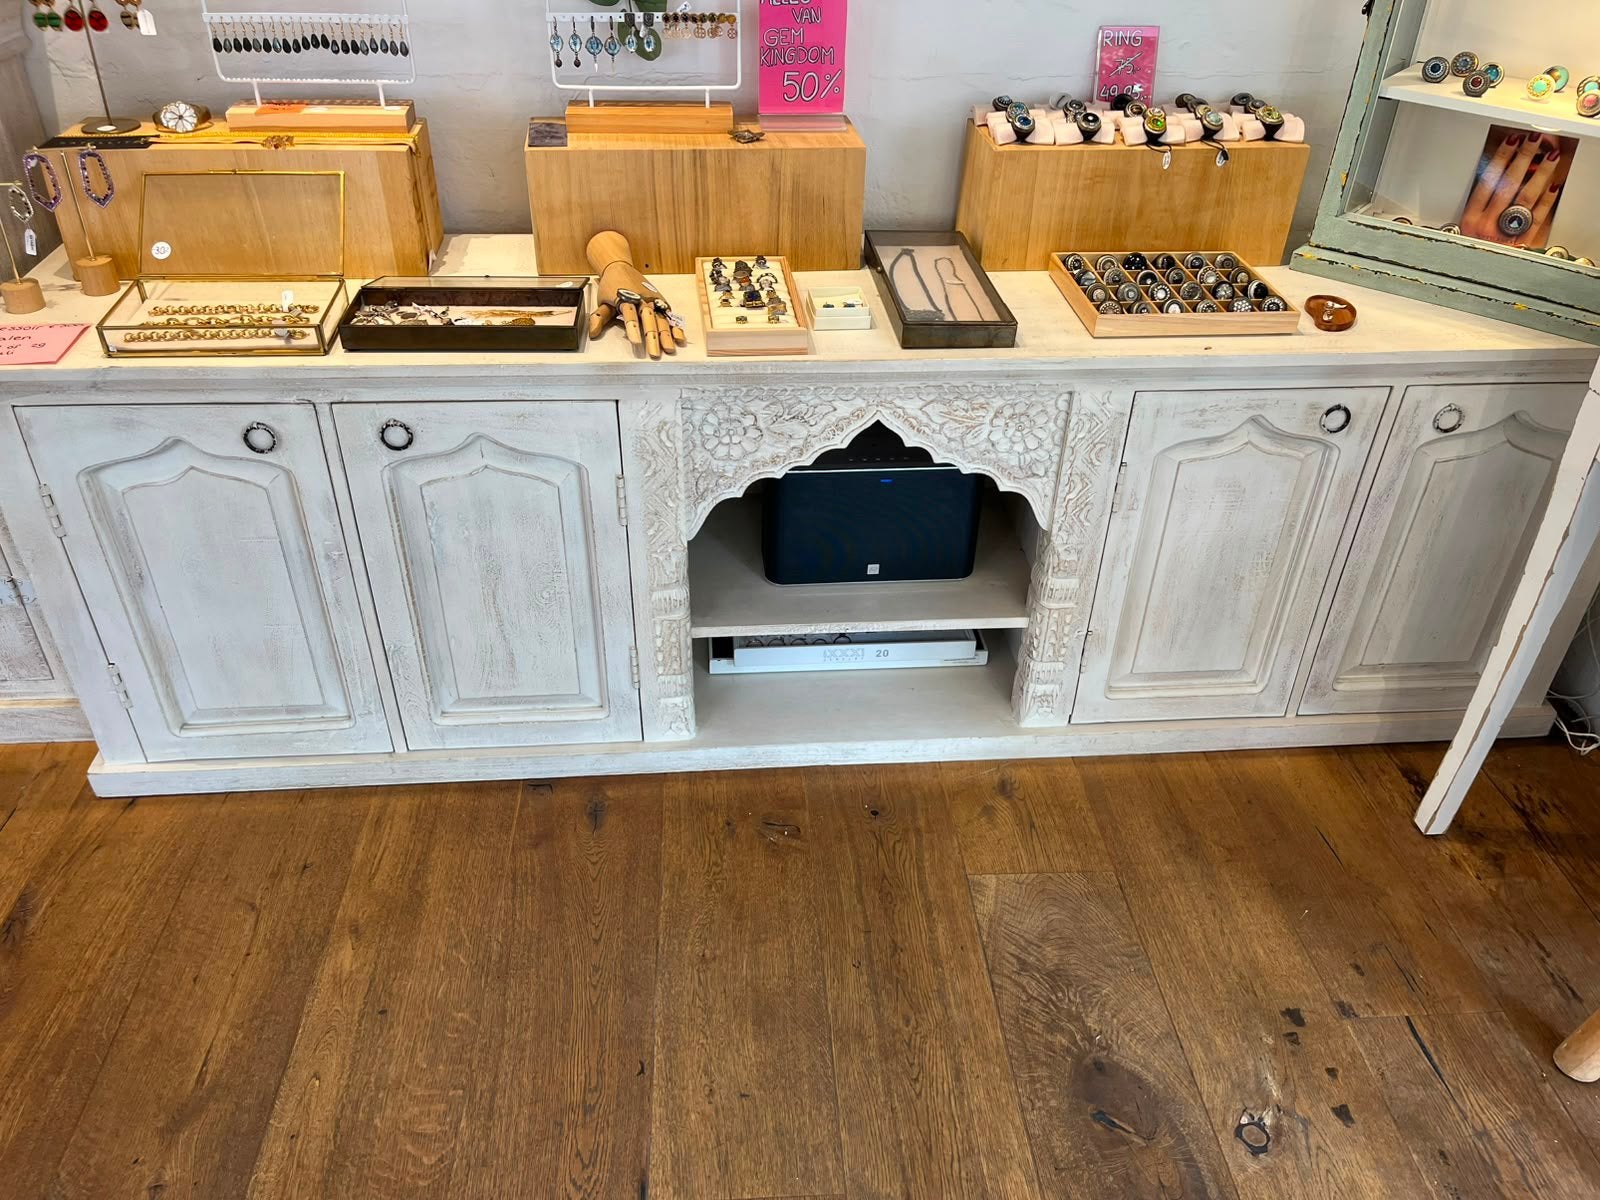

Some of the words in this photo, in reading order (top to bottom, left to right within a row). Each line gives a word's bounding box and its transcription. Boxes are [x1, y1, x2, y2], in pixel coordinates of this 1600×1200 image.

[792, 8, 821, 24] VAN
[763, 27, 804, 47] GEM
[1103, 29, 1143, 47] RING
[760, 47, 835, 67] KINGDOM
[783, 69, 842, 102] 50%
[875, 649, 889, 658] 20
